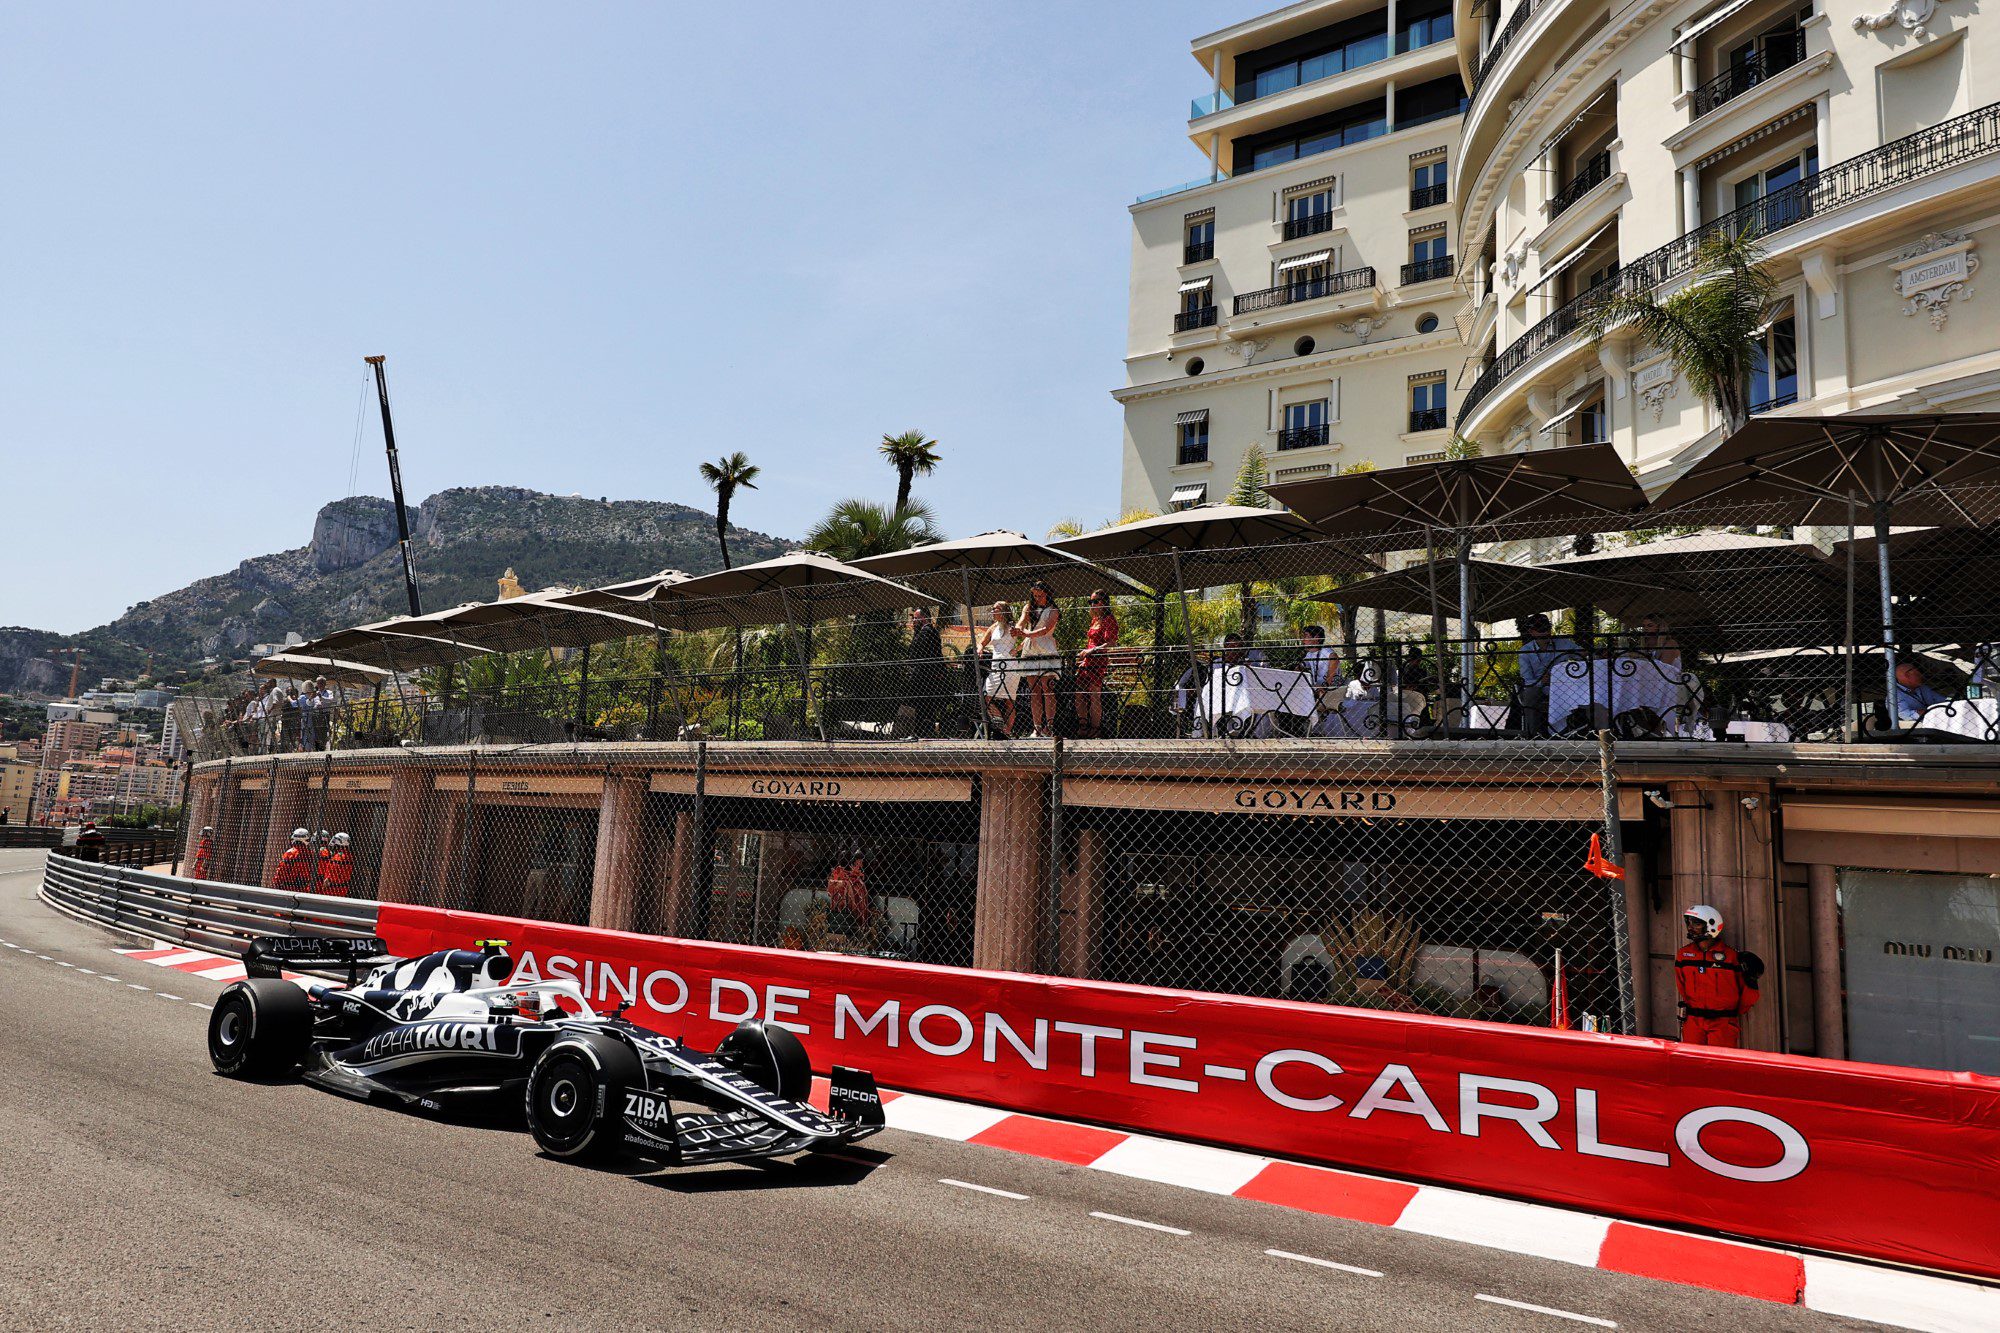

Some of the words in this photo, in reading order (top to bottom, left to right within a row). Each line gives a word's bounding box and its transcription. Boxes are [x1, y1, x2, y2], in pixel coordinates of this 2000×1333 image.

[1909, 261, 1956, 285] AMSTERDAM
[752, 780, 841, 796] GOYARD
[1234, 789, 1397, 811] GOYARD
[364, 1022, 497, 1060] ALPHATAURI
[480, 946, 688, 1014] ASINO
[708, 977, 811, 1035] DE
[833, 993, 1811, 1183] MONTE-CARLO
[624, 1094, 669, 1124] ZIBA
[634, 1118, 658, 1129] FOODS
[624, 1133, 670, 1152] zibafoods.com
